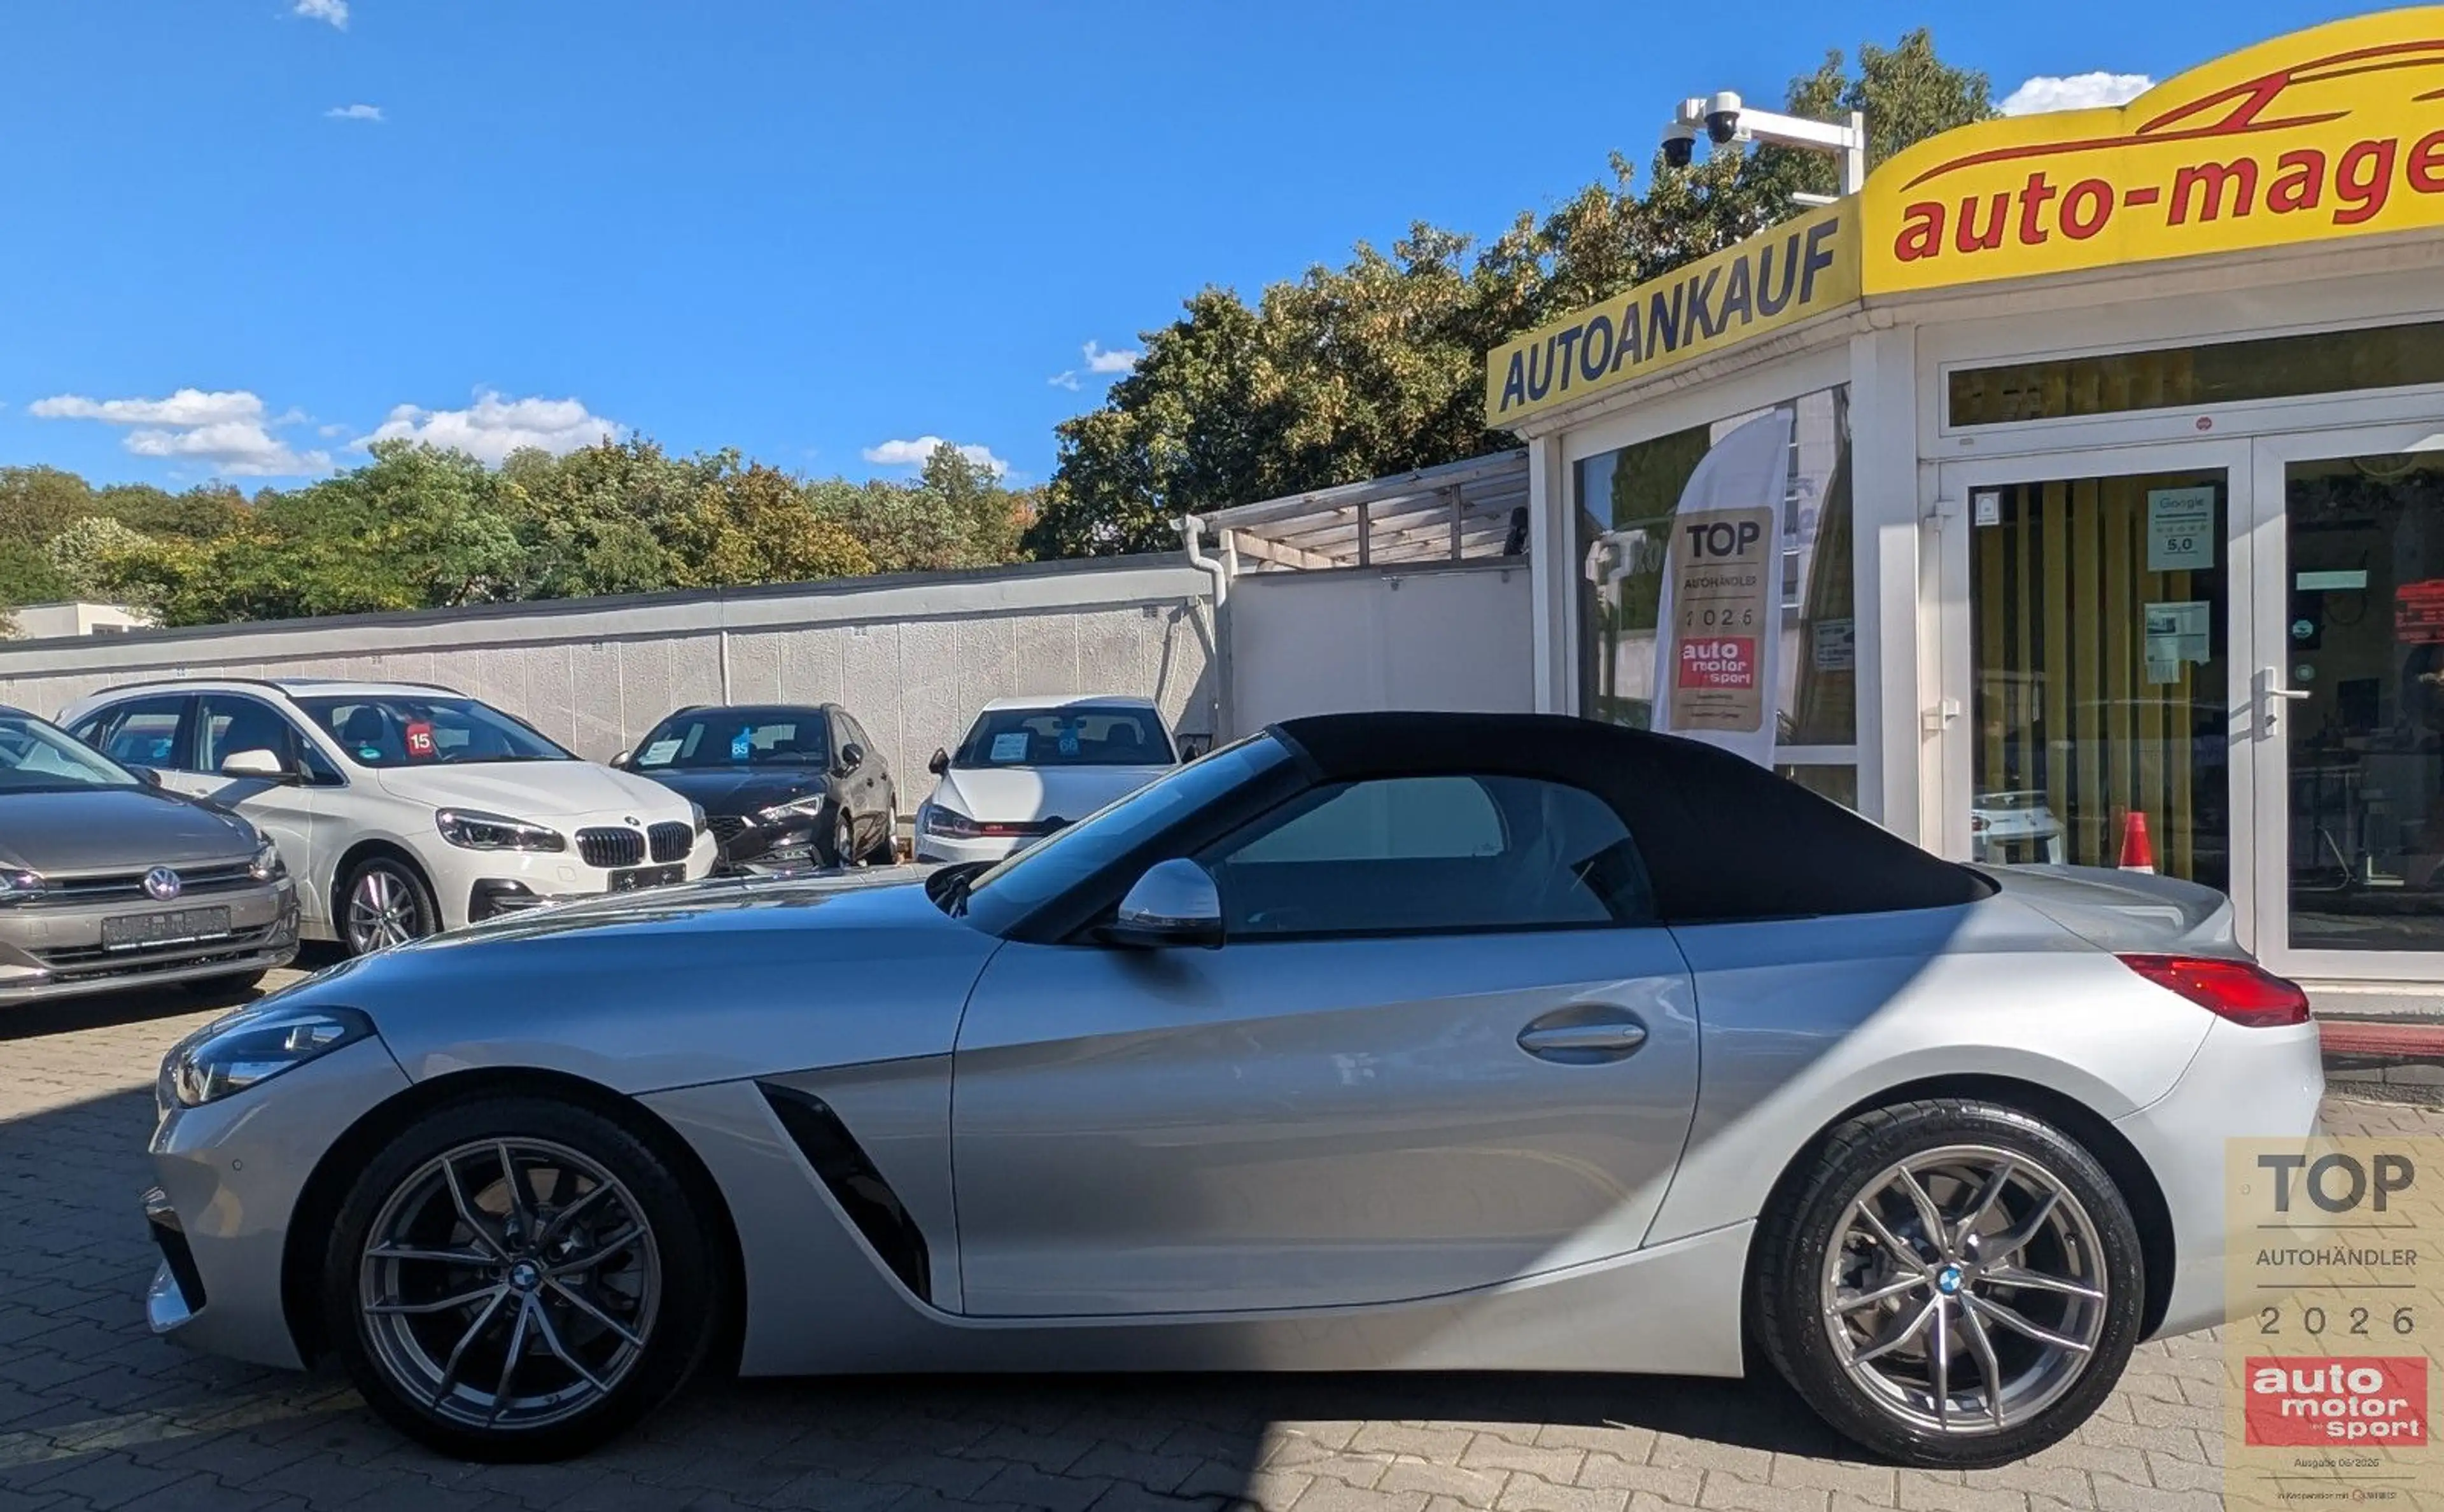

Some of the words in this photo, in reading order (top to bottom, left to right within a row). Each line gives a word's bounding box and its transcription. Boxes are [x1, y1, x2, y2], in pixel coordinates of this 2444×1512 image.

[1499, 217, 1839, 413] AUTOANKAUF
[1686, 521, 1760, 557] TOP
[1683, 641, 1738, 659] auto
[1692, 659, 1748, 671] motor
[411, 733, 430, 749] 15
[733, 743, 747, 755] 85
